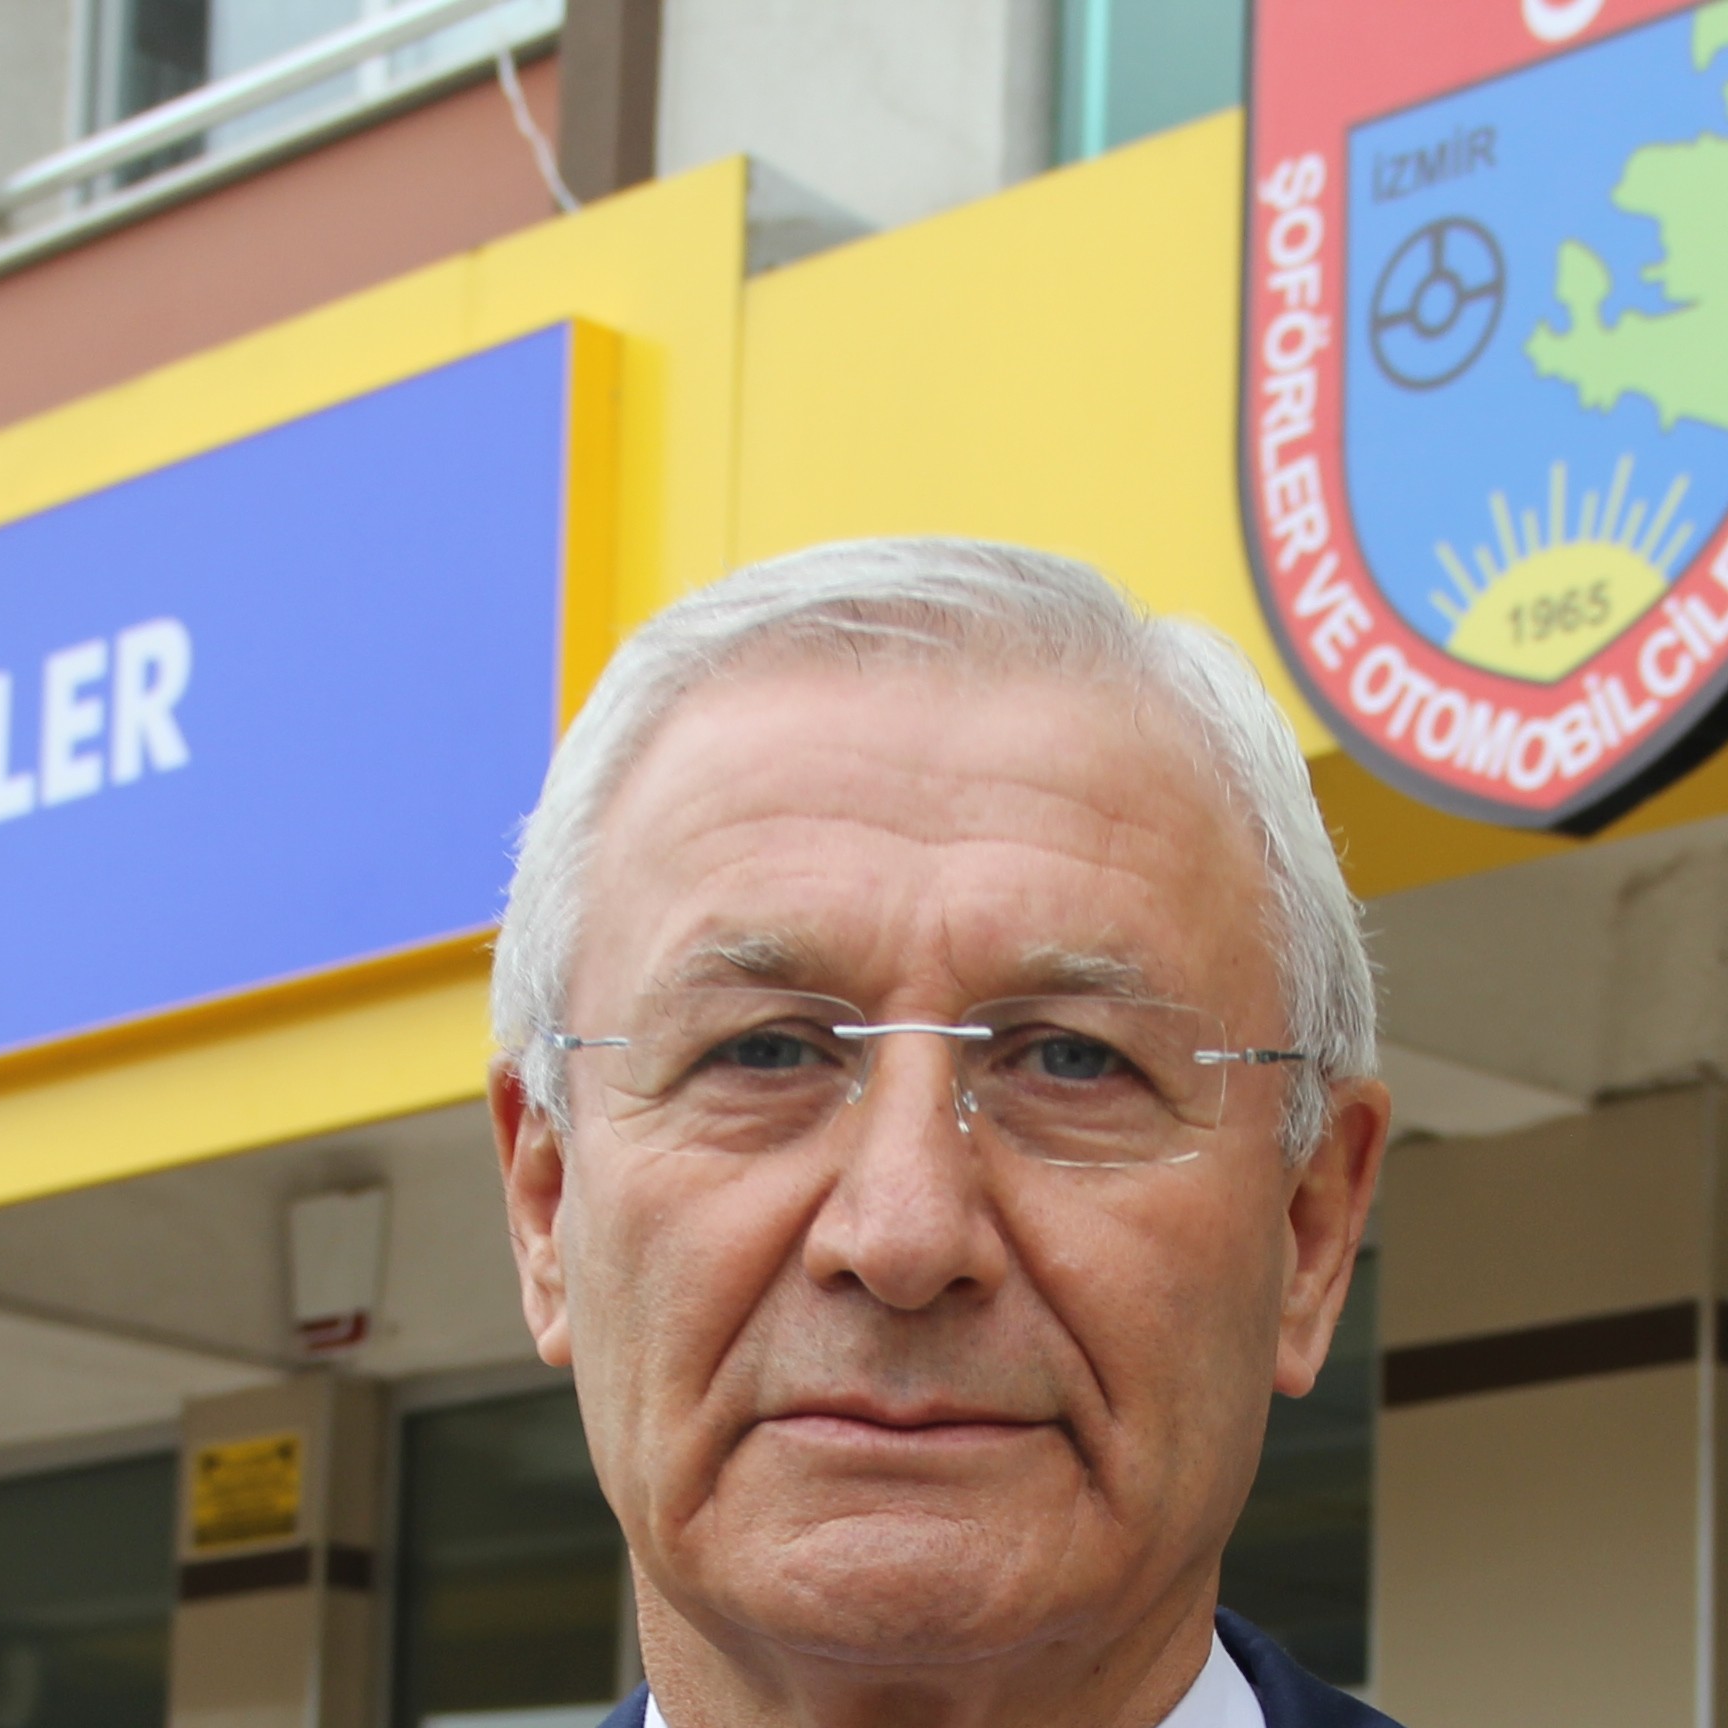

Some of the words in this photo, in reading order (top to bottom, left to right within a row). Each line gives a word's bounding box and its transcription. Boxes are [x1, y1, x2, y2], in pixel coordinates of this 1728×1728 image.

[1372, 124, 1498, 205] İZMİR
[1257, 151, 1331, 572] ŞOFÖRLER
[1293, 551, 1373, 671] VE
[1508, 578, 1613, 648] 1965
